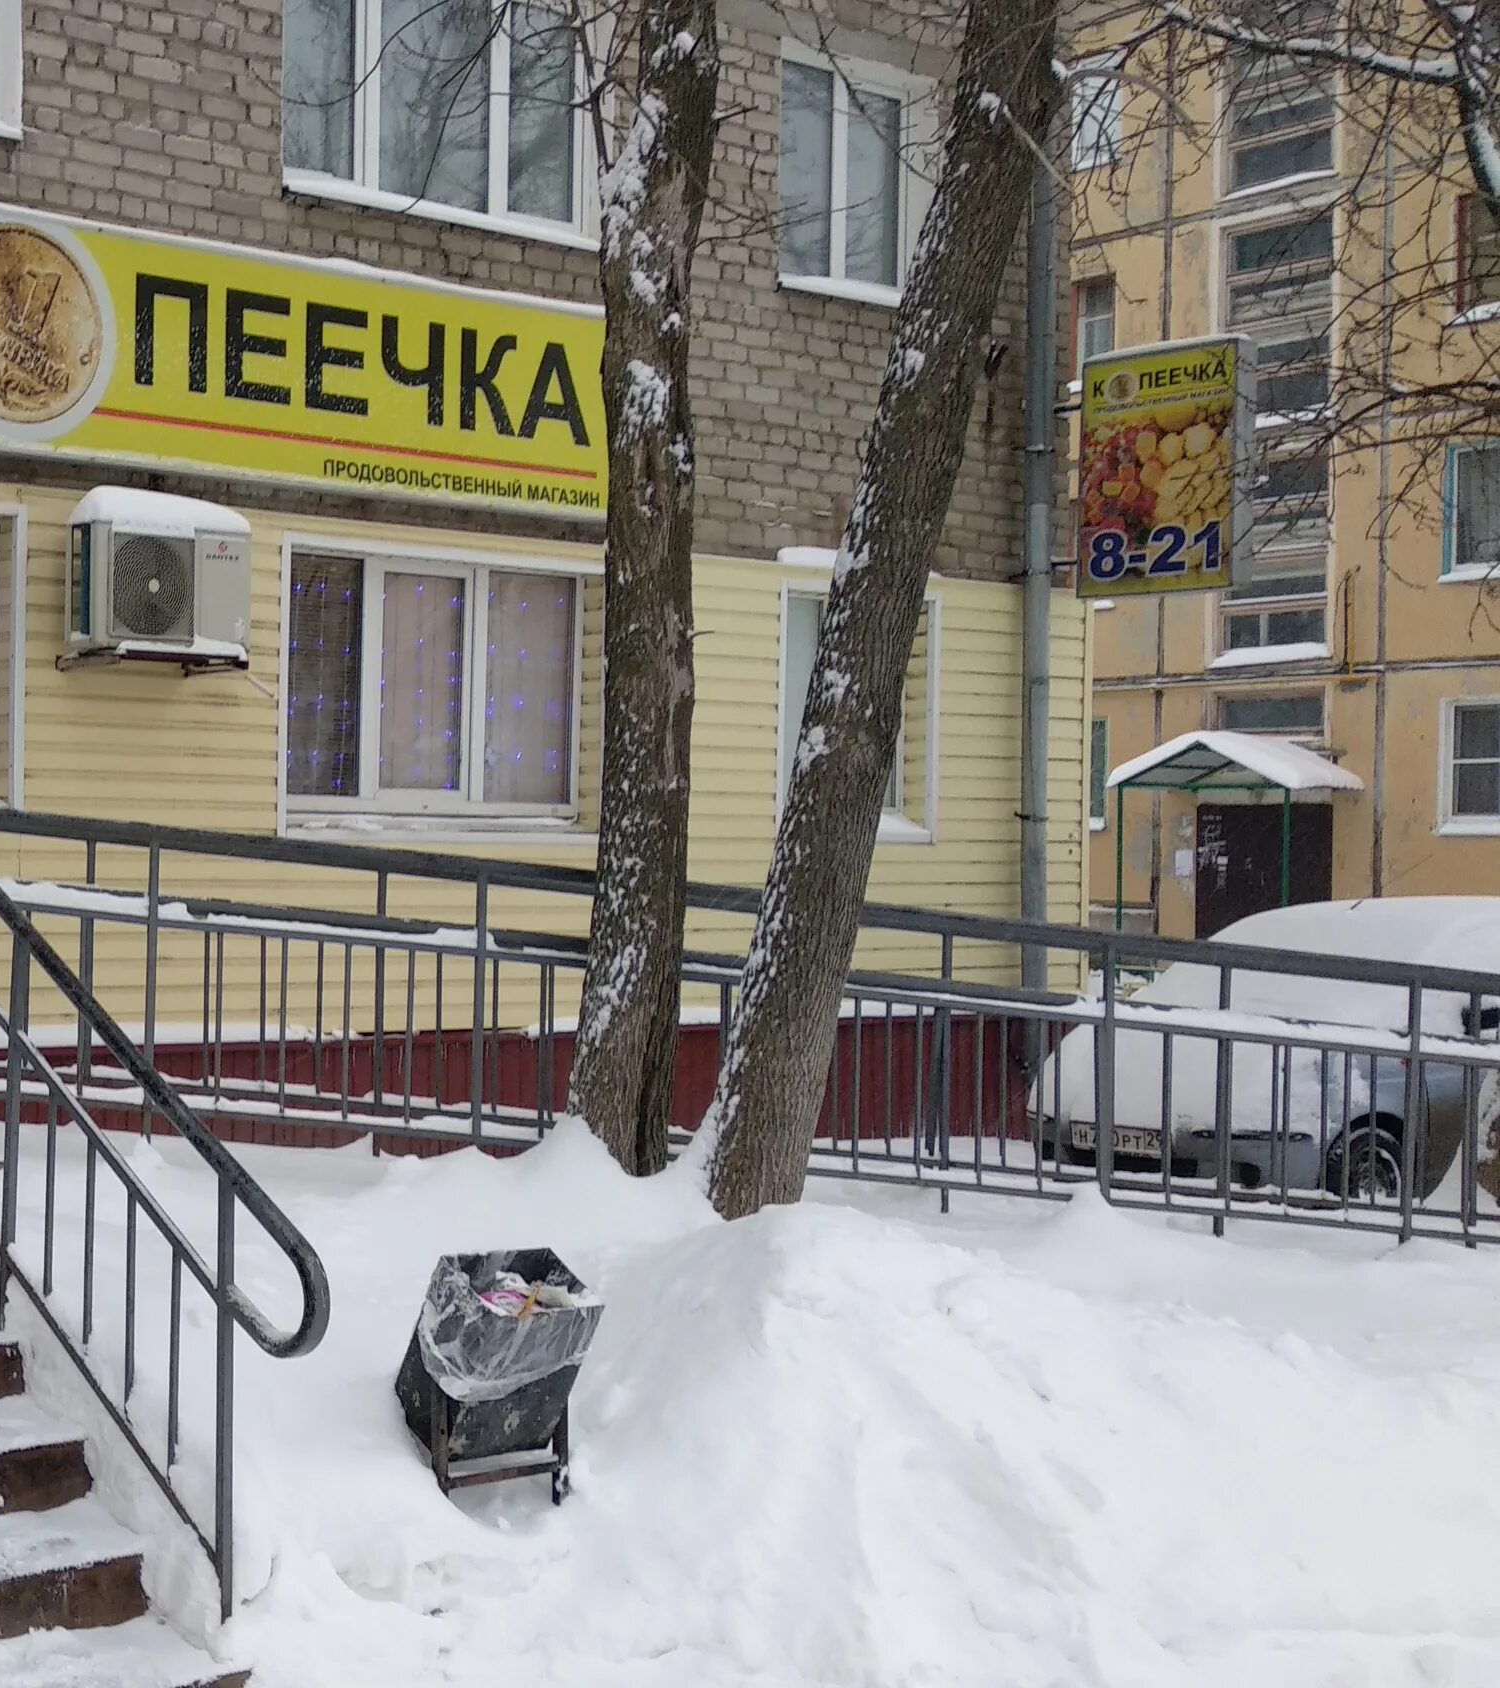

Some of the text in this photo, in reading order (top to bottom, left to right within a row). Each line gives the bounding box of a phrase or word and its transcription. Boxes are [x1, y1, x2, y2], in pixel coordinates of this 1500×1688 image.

[322, 458, 601, 509] ПРОДОВОЛЬСТВЕННЫЙ МАГАЗИН
[1088, 519, 1222, 581] 8-21
